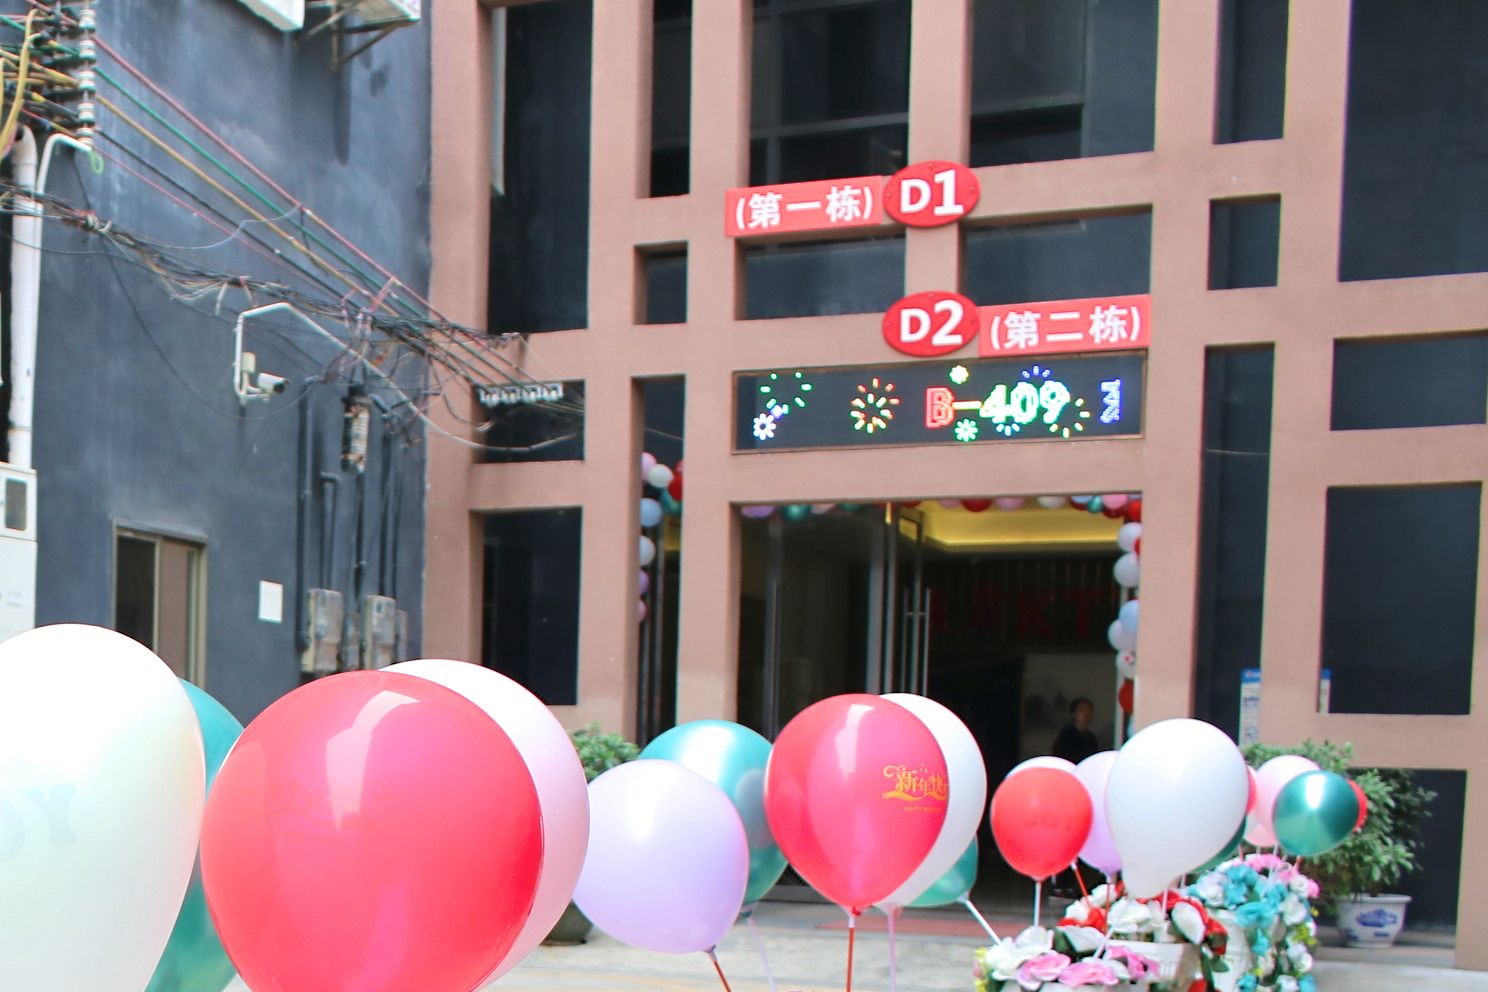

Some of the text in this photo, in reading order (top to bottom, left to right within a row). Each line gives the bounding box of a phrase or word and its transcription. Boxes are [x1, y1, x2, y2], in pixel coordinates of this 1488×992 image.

[735, 169, 964, 230] (第一栋) D1
[900, 298, 1141, 350] D2 (第二栋)
[926, 379, 1071, 428] B-409
